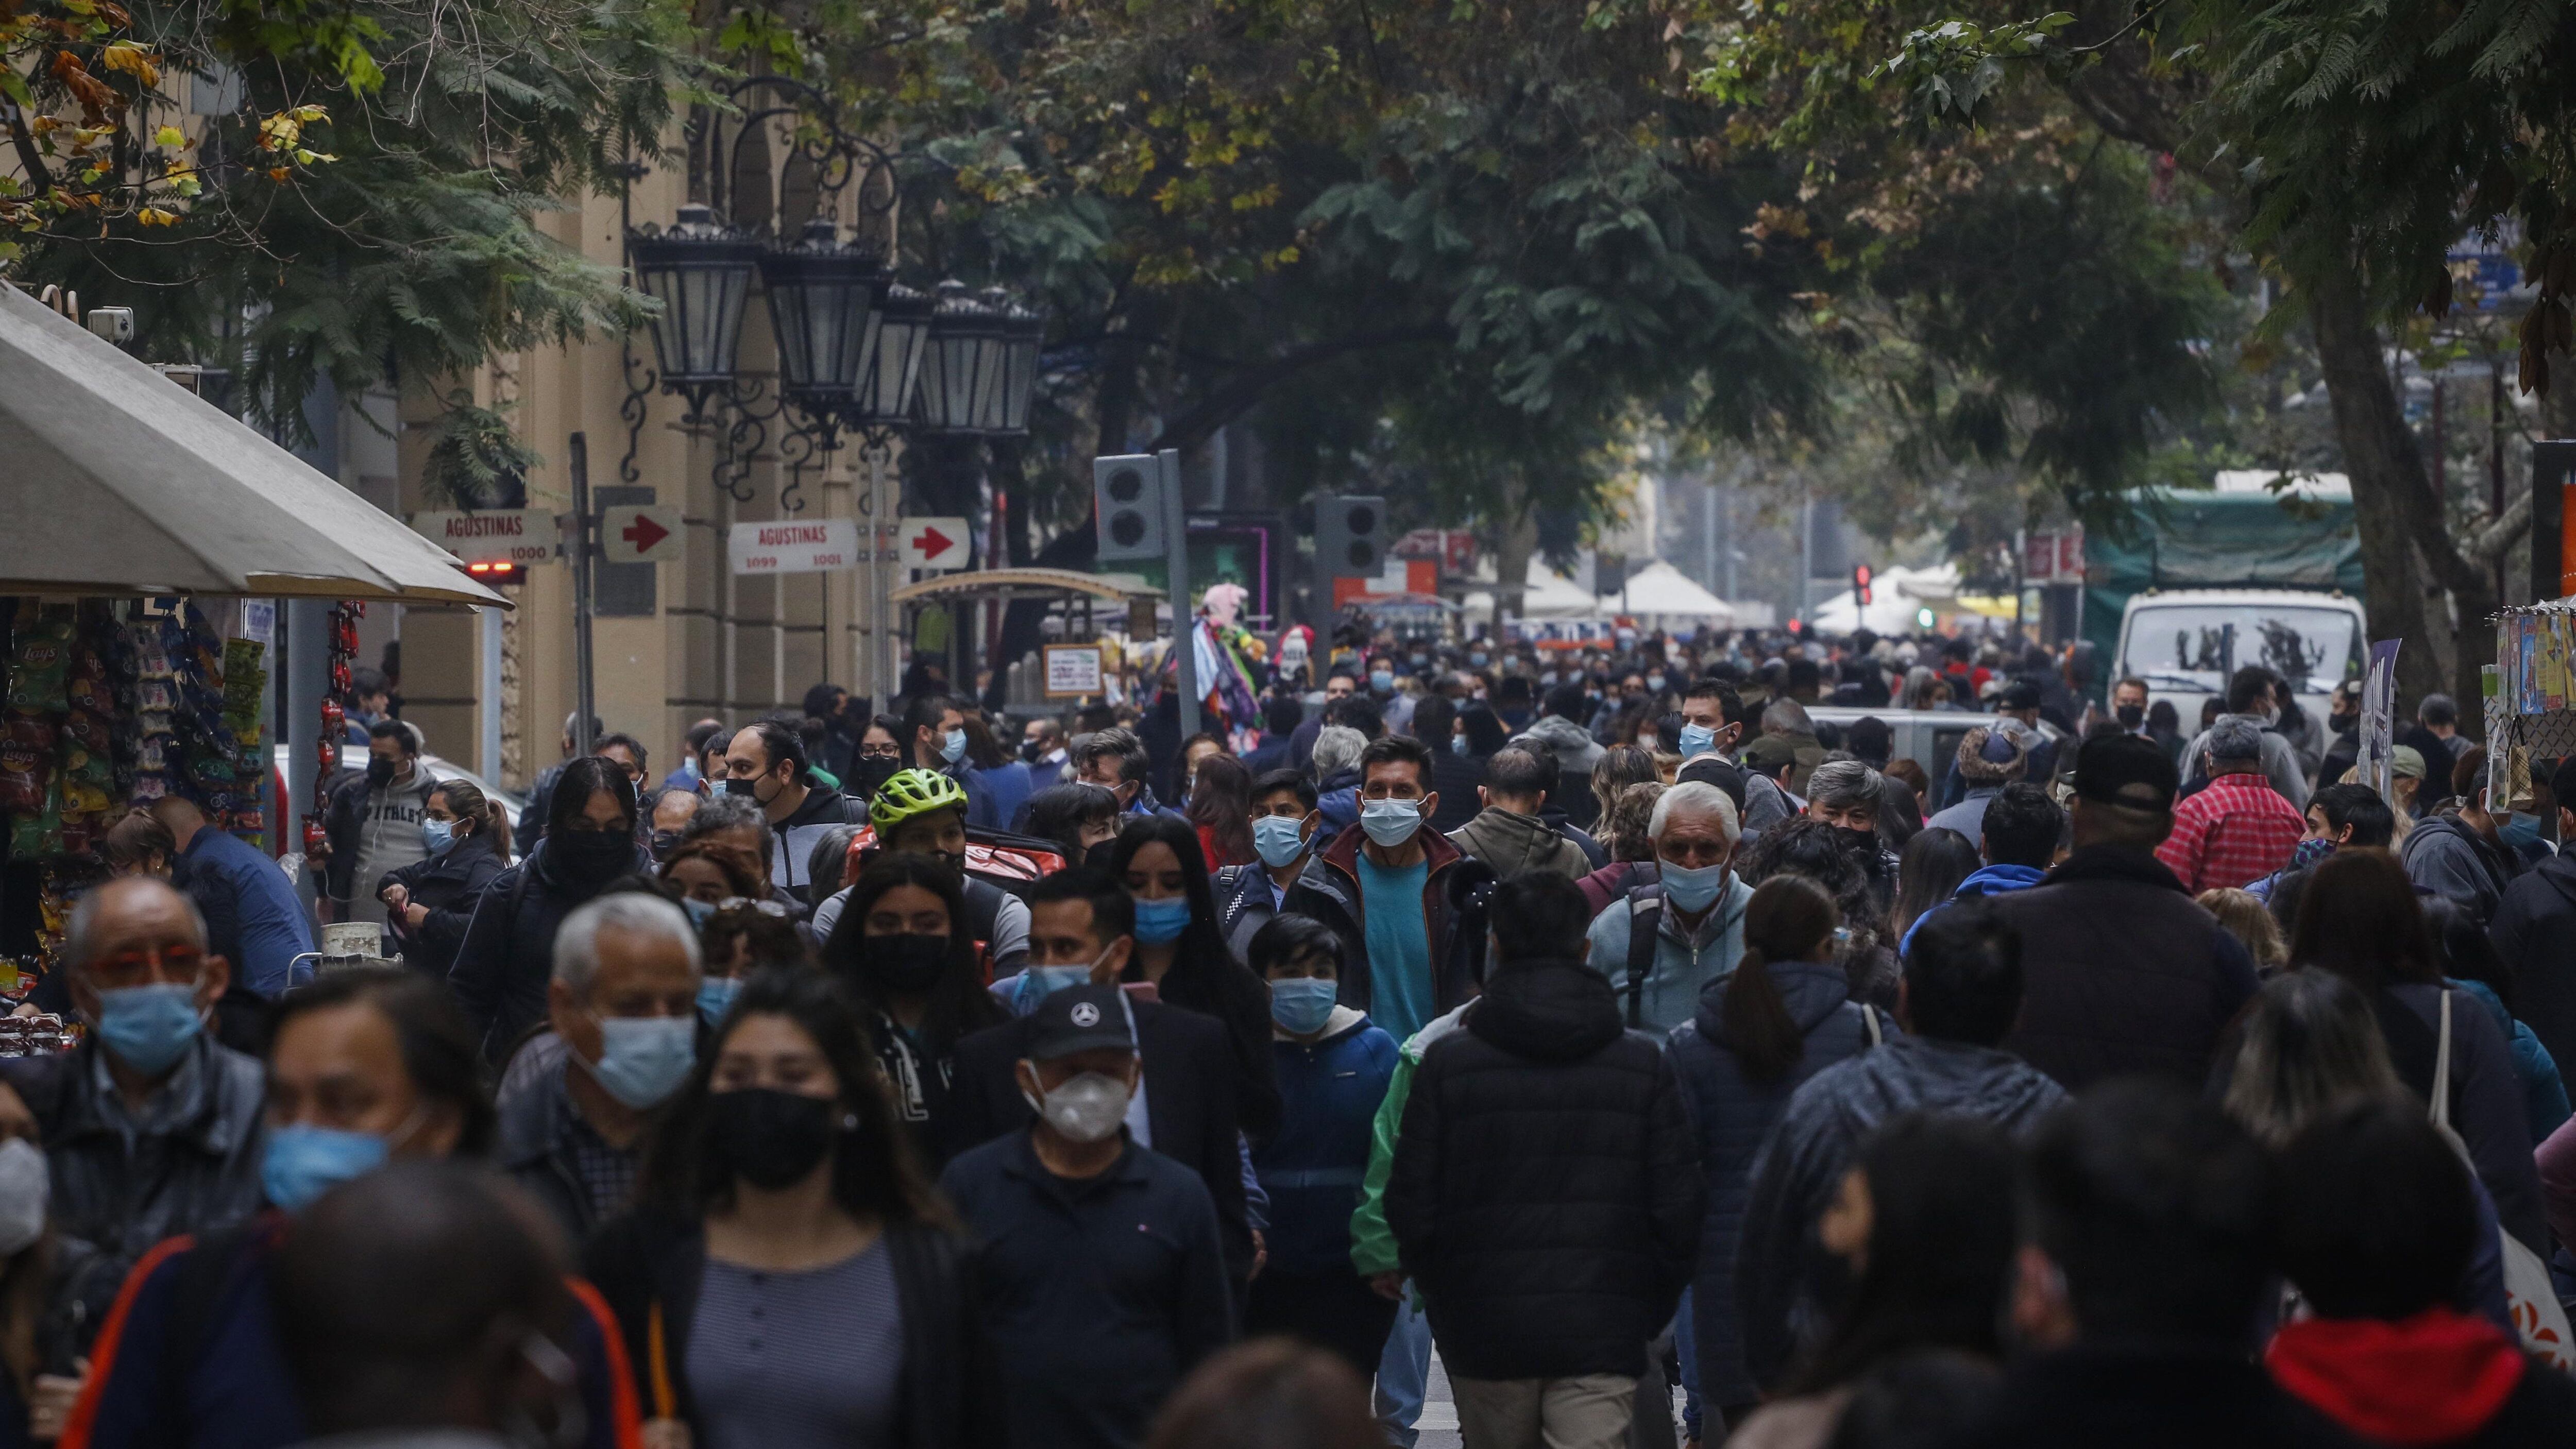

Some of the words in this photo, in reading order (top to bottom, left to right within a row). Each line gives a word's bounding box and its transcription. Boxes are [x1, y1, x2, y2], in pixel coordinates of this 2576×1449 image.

[446, 516, 523, 537] AGUSTINAS
[758, 526, 827, 545] AGUSTINAS
[512, 547, 547, 559] 1000
[747, 556, 777, 569] 1099
[814, 554, 841, 565] 1001
